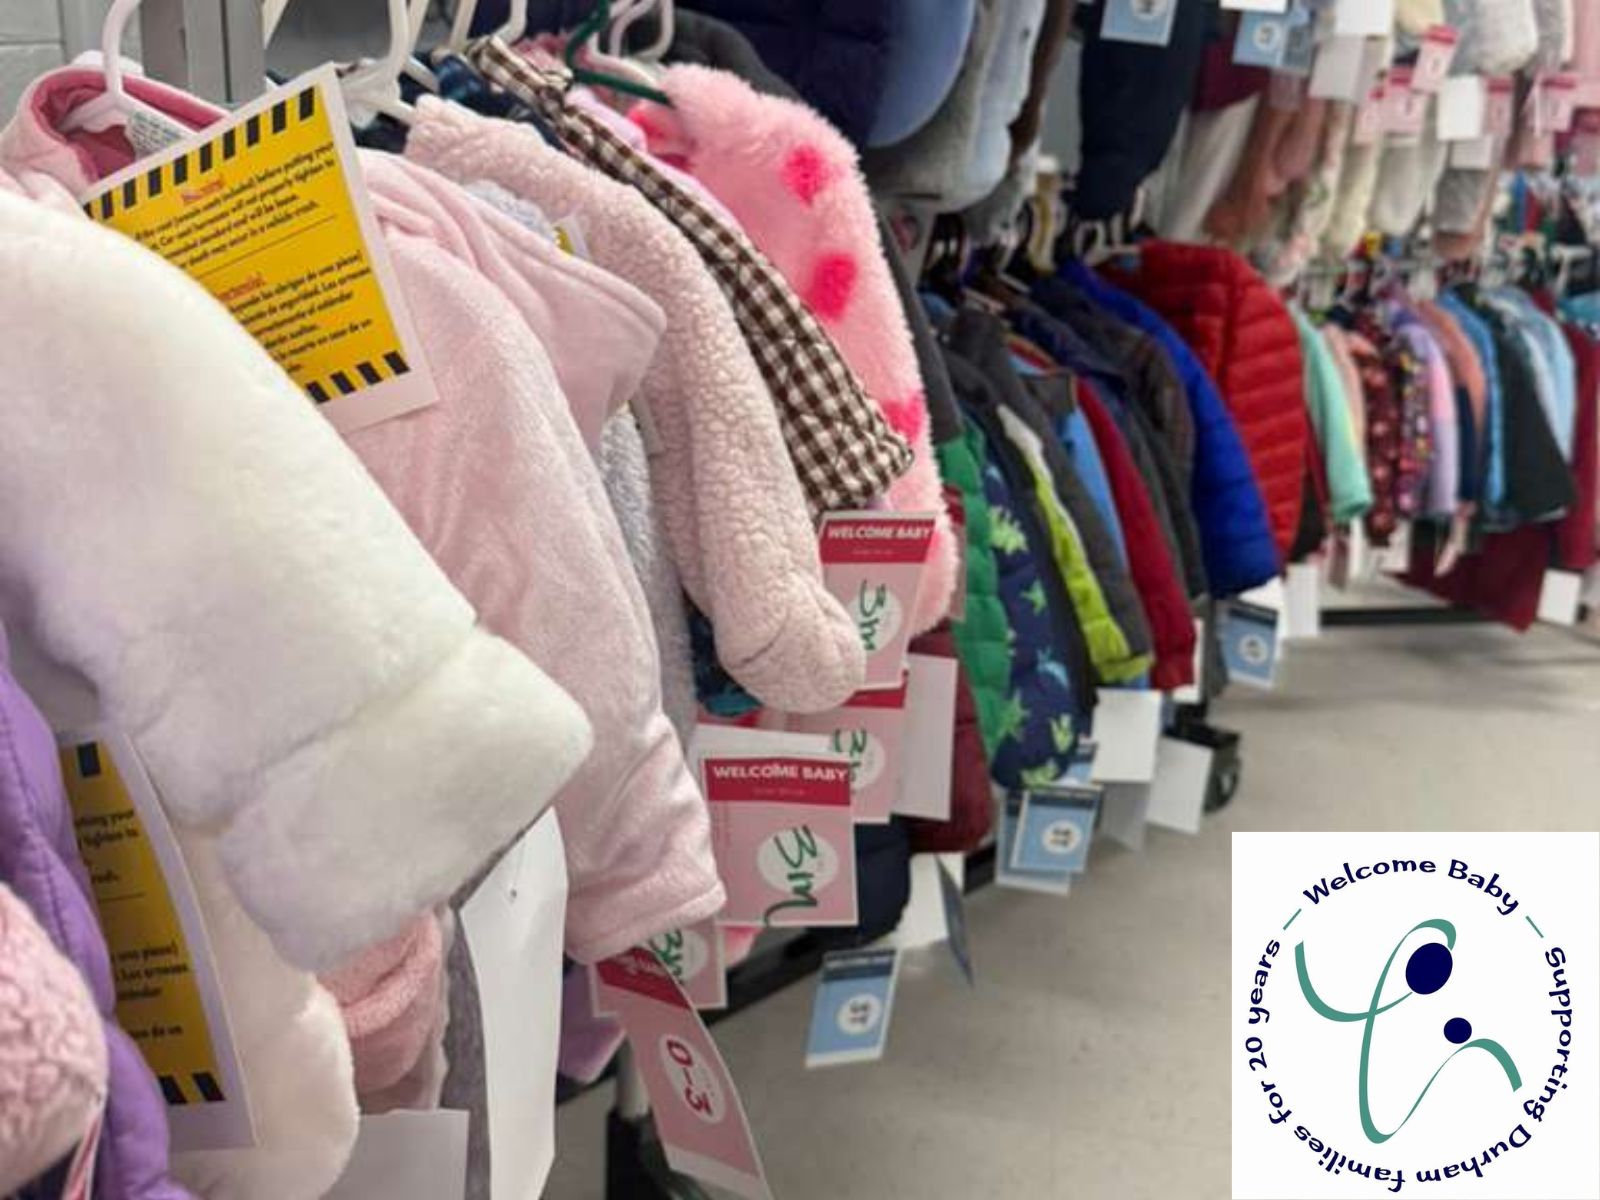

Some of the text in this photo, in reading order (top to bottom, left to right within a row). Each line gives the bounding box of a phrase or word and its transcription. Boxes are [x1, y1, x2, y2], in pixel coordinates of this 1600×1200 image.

[828, 525, 934, 540] WELCOME BABY
[713, 763, 848, 781] WELCOME BABY
